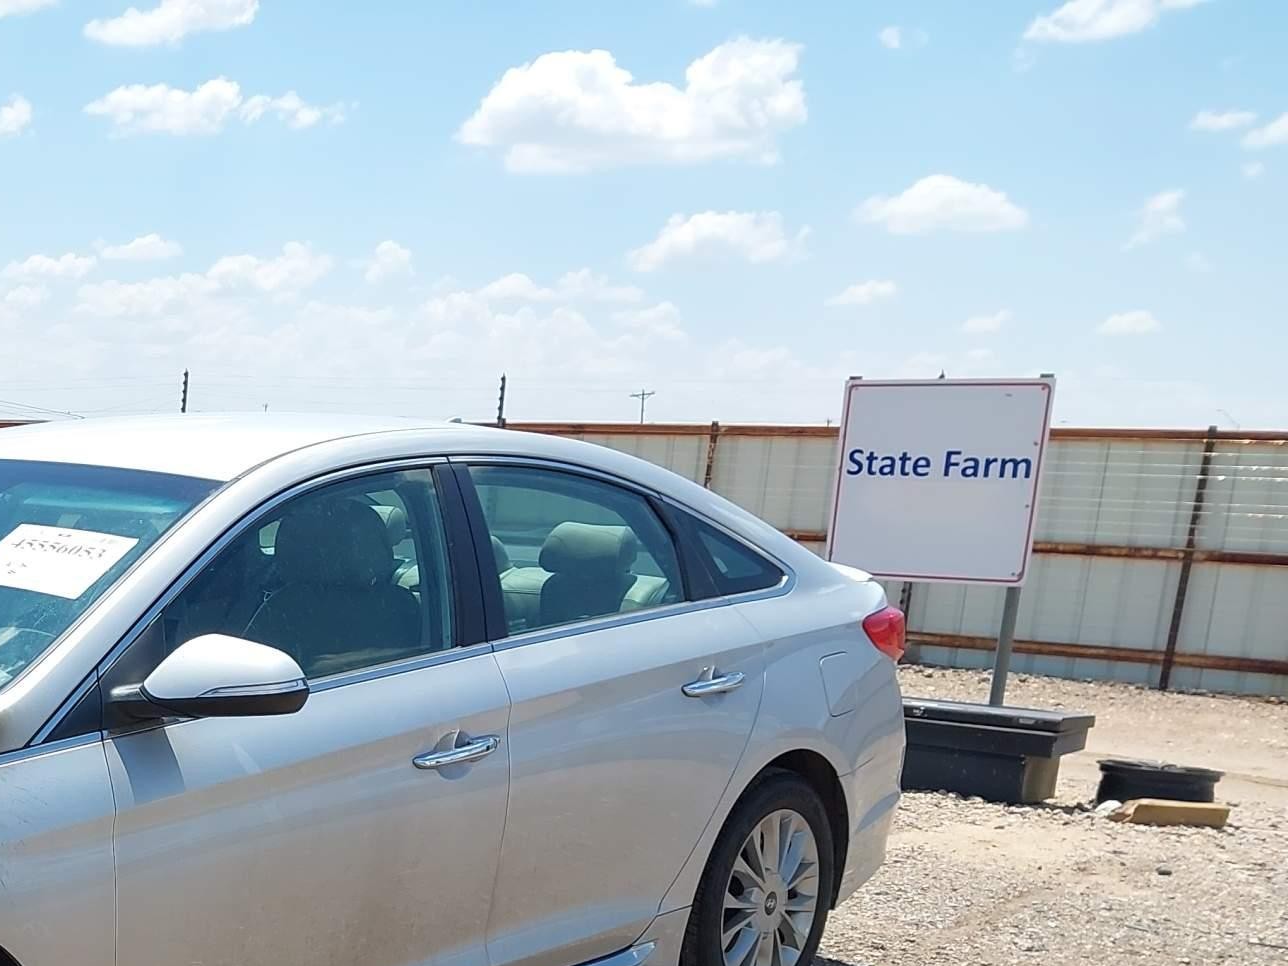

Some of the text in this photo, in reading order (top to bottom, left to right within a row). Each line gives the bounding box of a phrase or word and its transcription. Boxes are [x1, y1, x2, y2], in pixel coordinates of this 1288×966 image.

[846, 448, 1032, 480] State Farm
[10, 537, 108, 560] 45556053
